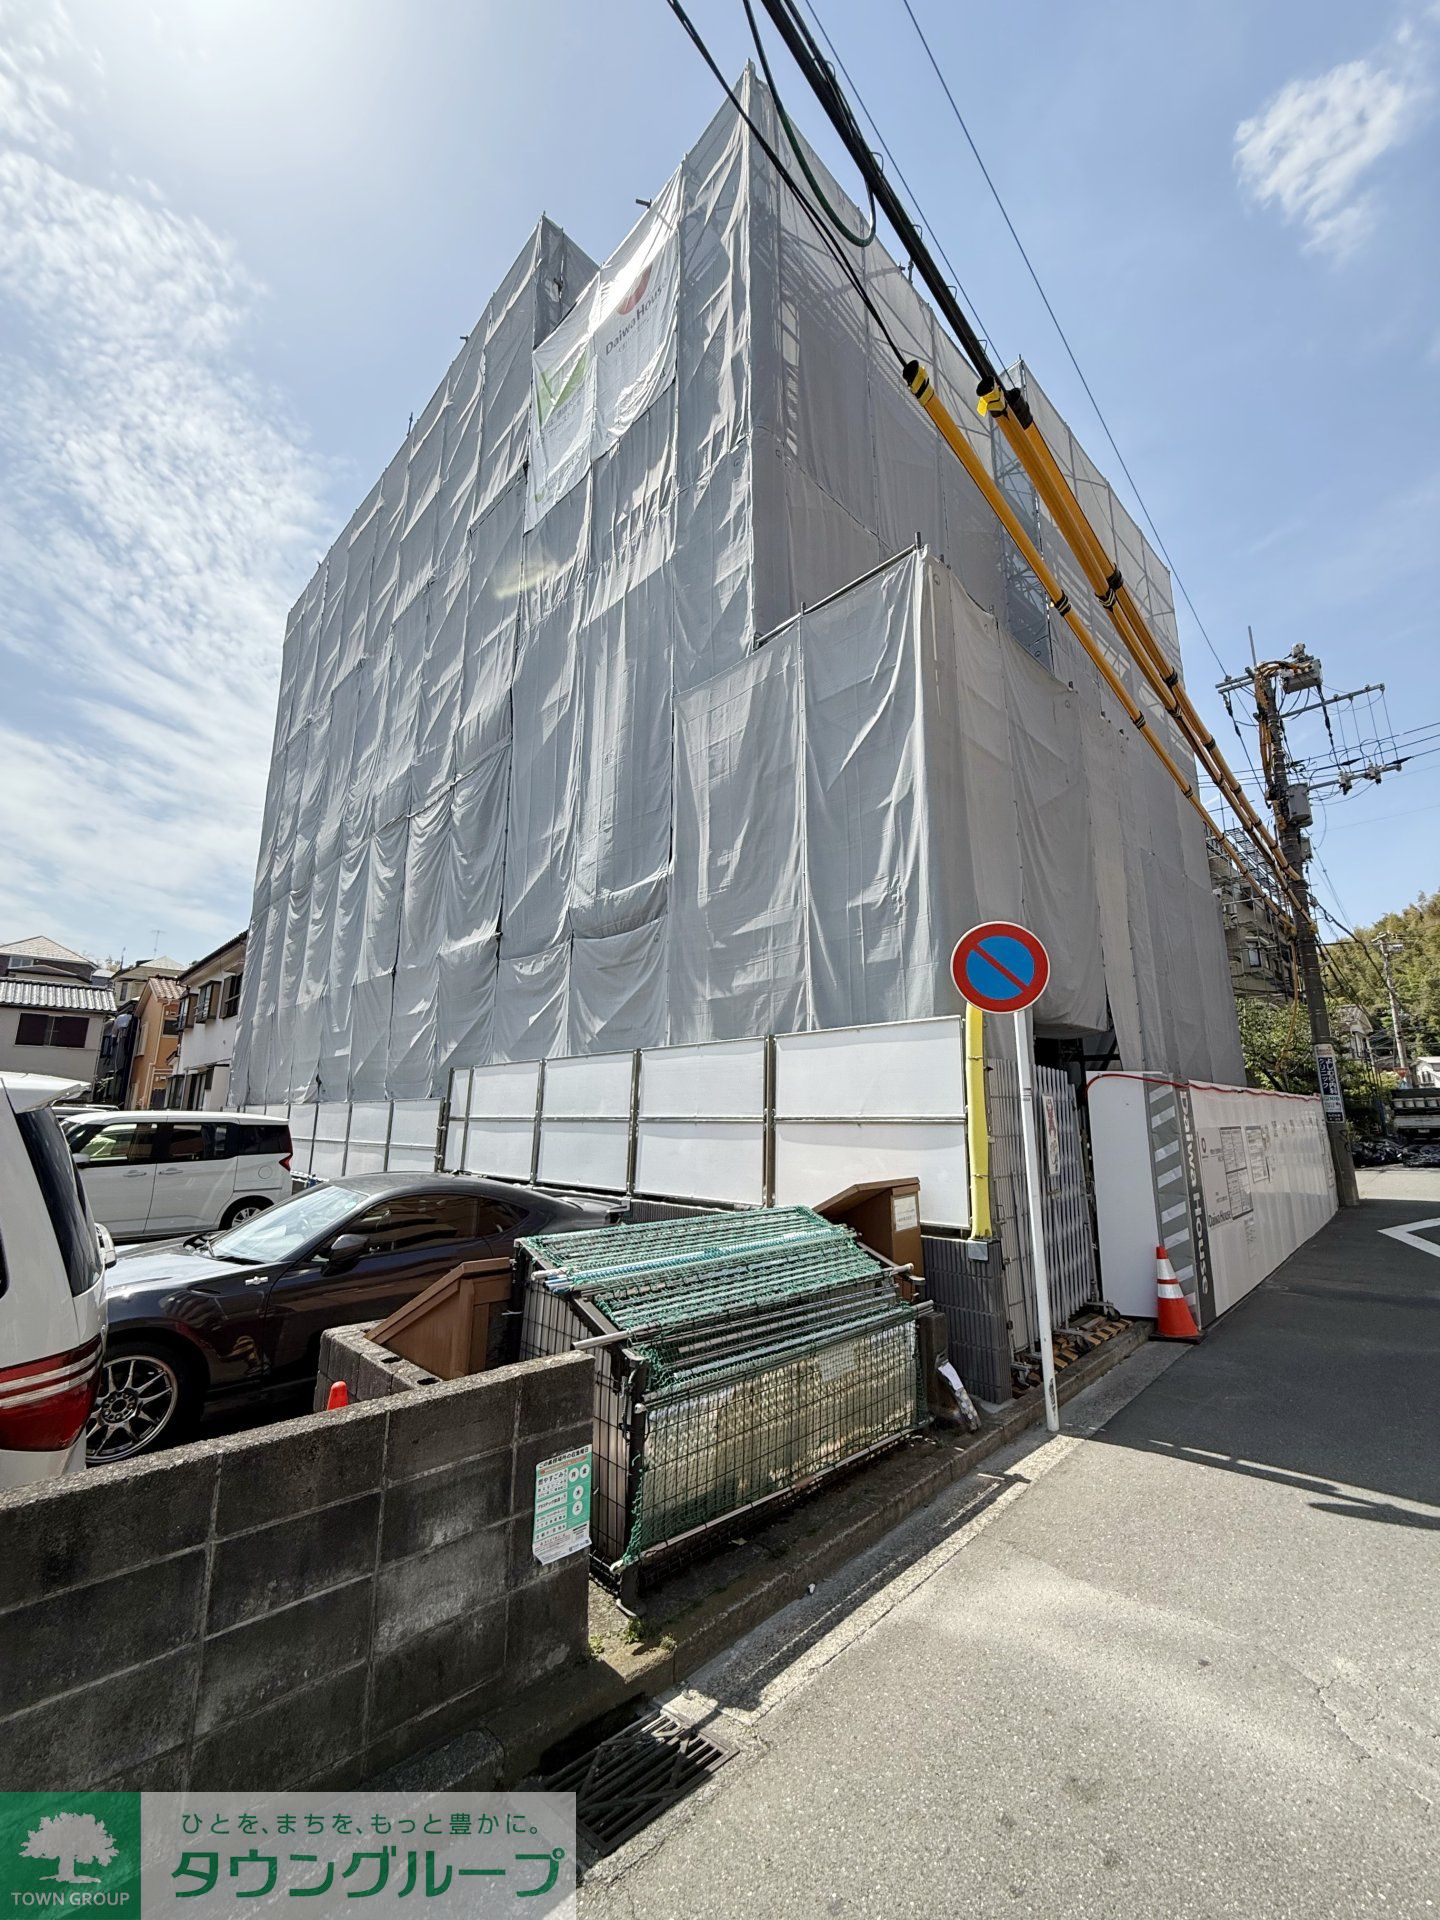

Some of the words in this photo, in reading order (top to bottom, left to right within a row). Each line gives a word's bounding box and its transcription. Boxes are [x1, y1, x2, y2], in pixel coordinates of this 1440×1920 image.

[606, 317, 636, 356] Daiwa
[1180, 1091, 1197, 1187] Daiwa
[1193, 1192, 1209, 1295] House
